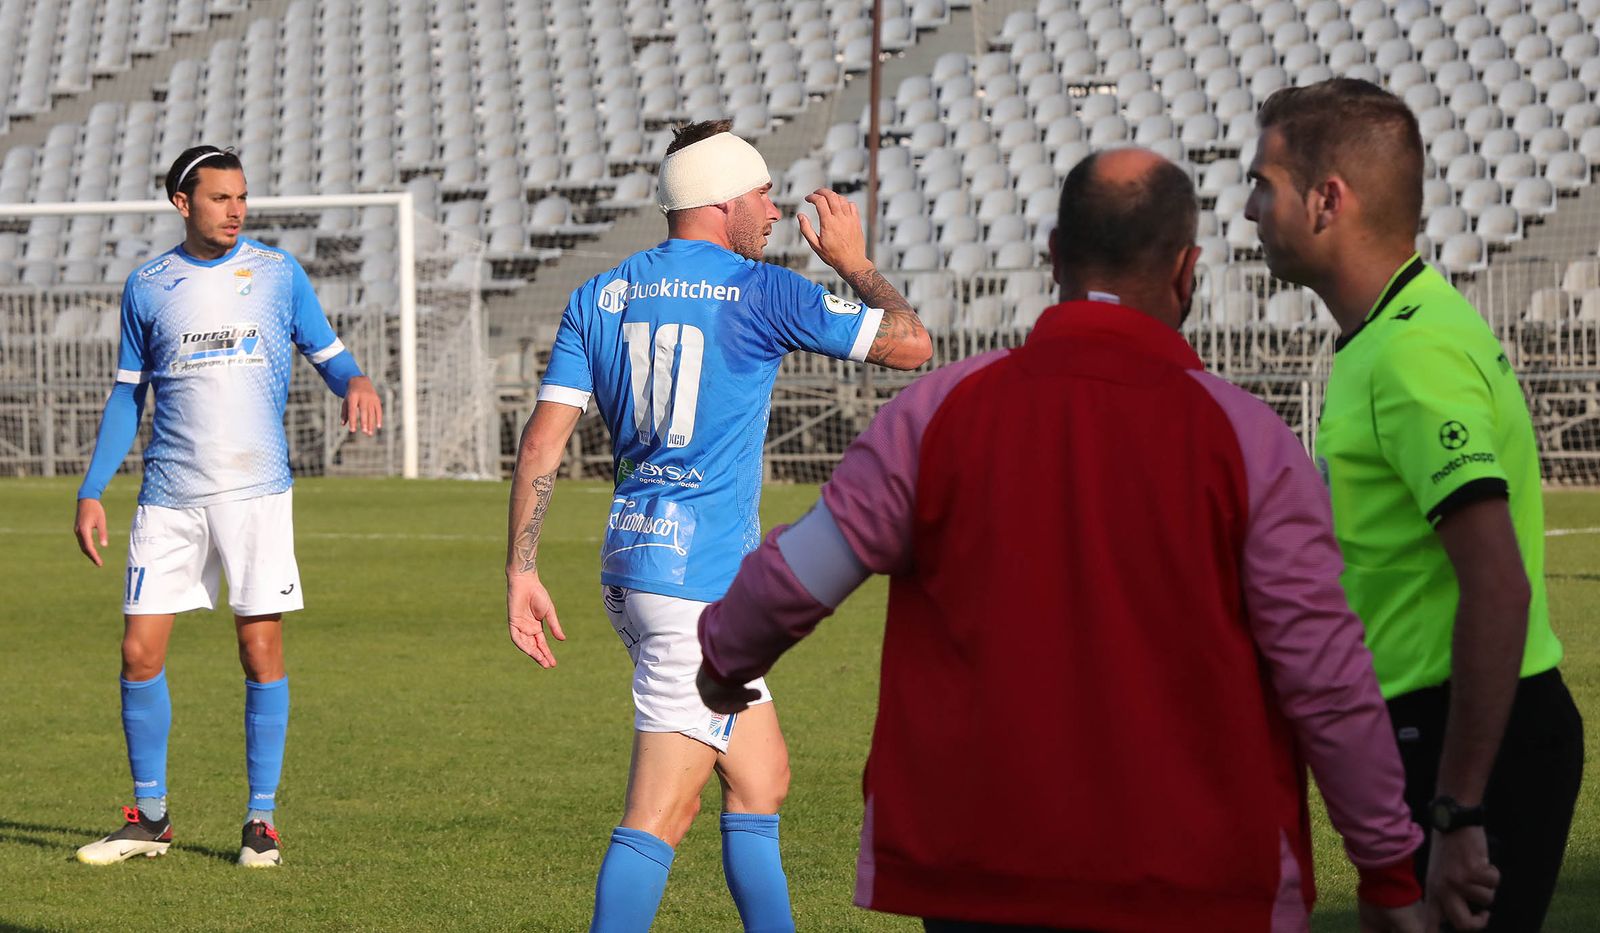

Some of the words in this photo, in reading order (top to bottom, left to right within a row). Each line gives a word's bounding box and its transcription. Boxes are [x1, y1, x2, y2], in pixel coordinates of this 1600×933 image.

[142, 259, 171, 277] LUGO
[630, 277, 740, 302] duokitchen
[623, 322, 705, 448] 10
